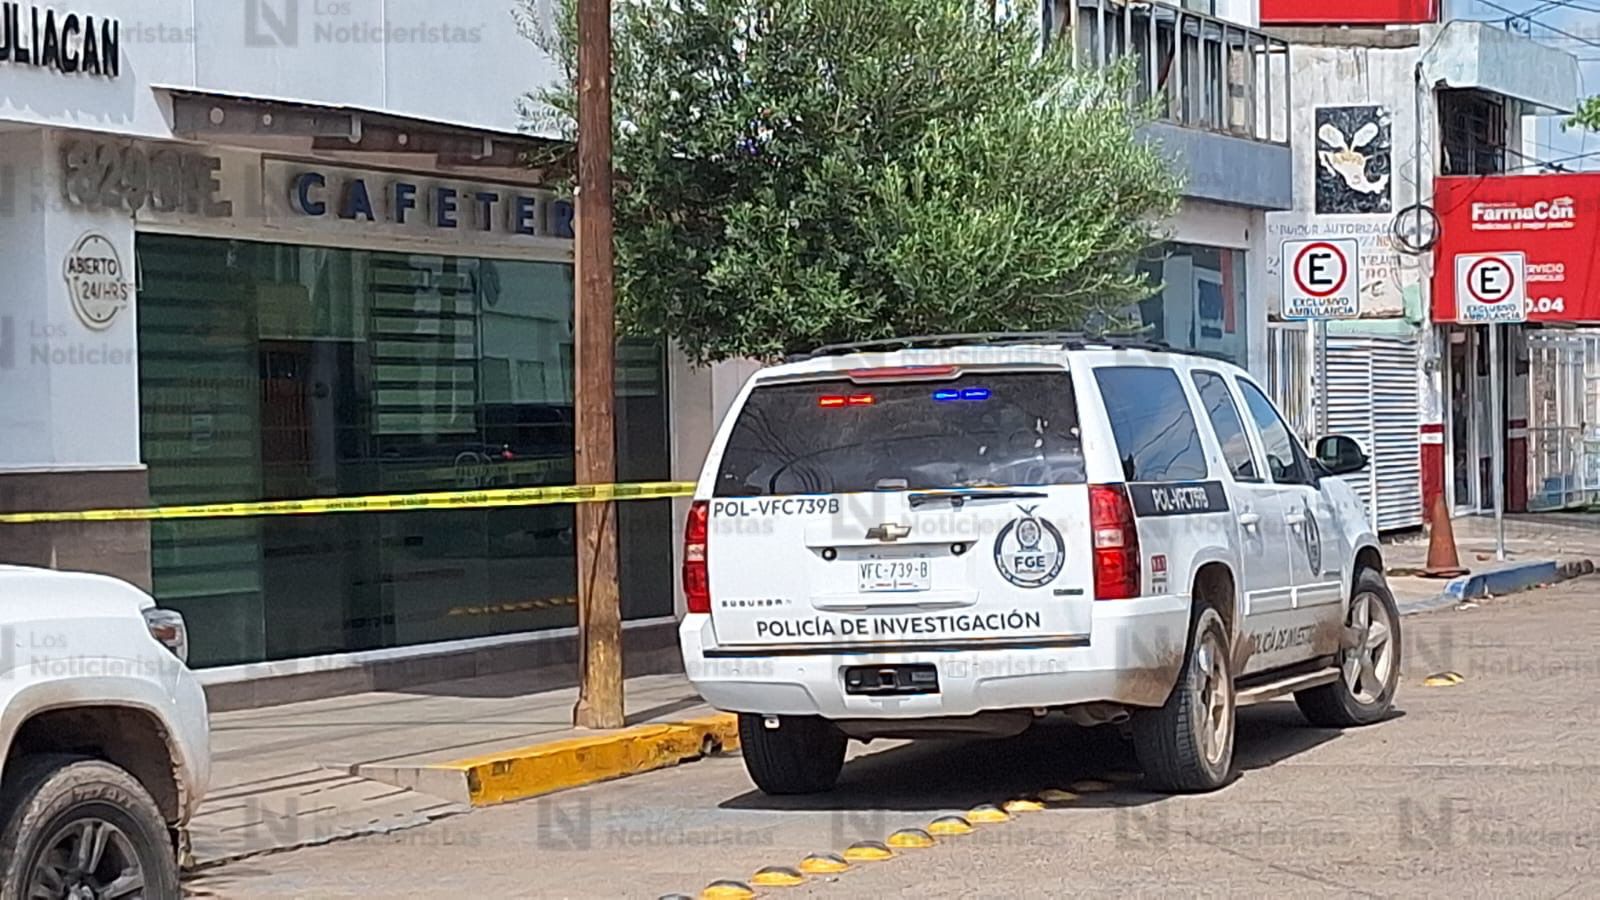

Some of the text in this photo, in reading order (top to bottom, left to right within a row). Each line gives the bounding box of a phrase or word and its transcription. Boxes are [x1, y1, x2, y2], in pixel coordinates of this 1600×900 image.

[1309, 253, 1333, 285] E
[1480, 266, 1502, 294] E
[713, 499, 840, 517] POL-VFC739B
[860, 561, 928, 580] VFC-739-B
[1014, 556, 1046, 568] FGE
[756, 609, 1041, 637] POLICÍA DE INVESTIGACIÓN
